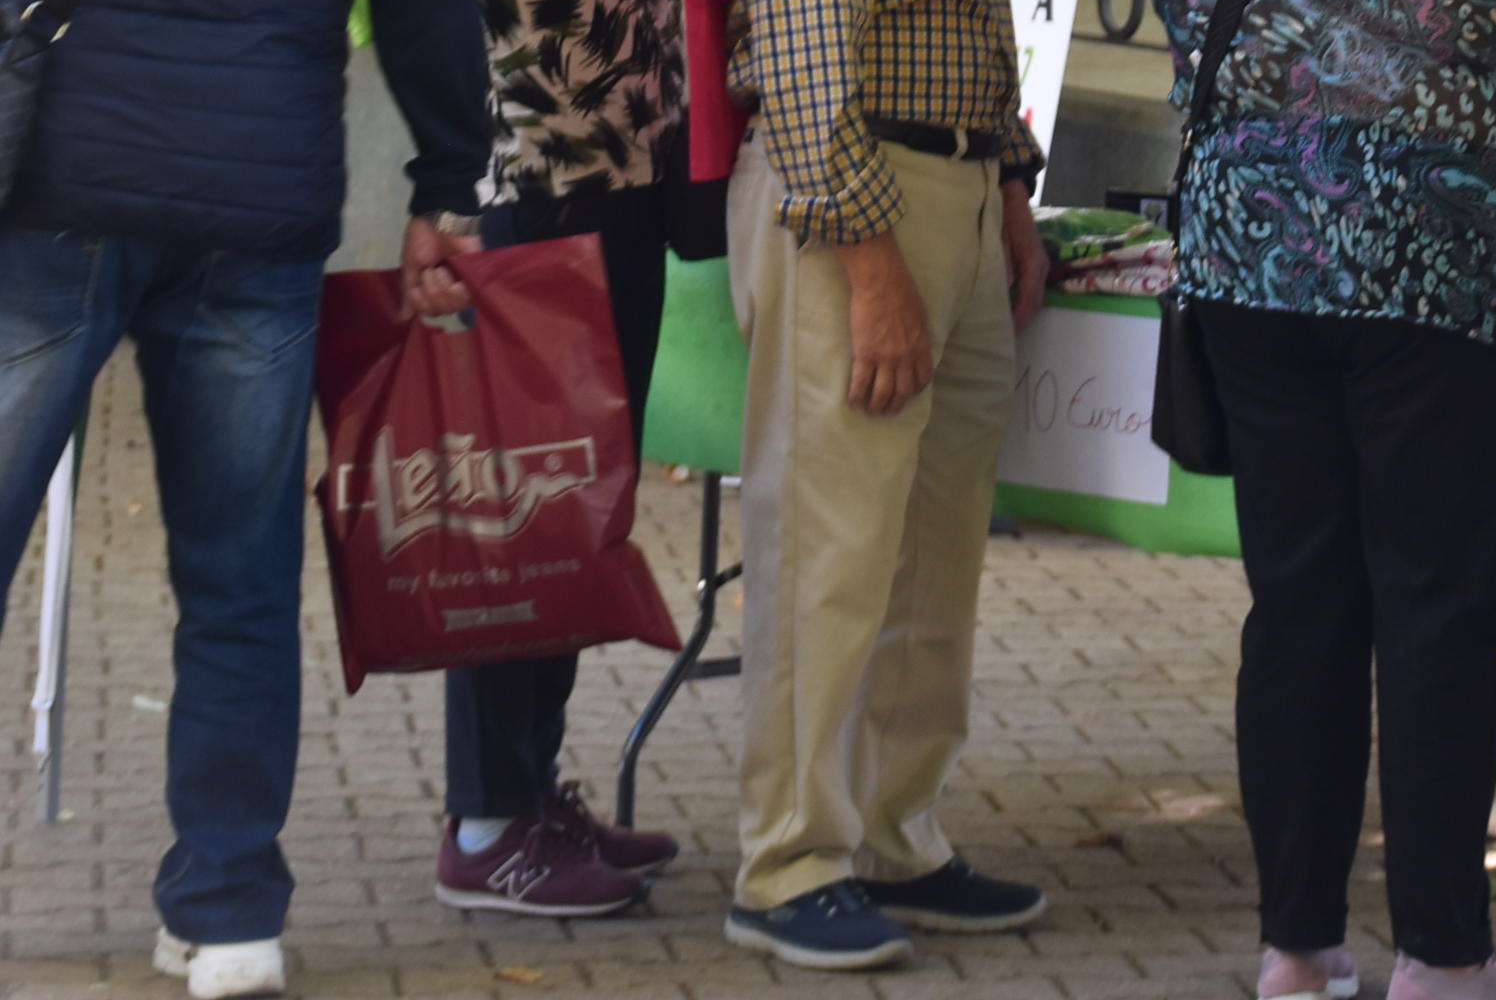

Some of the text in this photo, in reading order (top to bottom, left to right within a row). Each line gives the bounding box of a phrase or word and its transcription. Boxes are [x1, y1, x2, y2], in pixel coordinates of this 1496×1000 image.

[1014, 366, 1059, 433] 10
[387, 557, 582, 595] my favorite jeans
